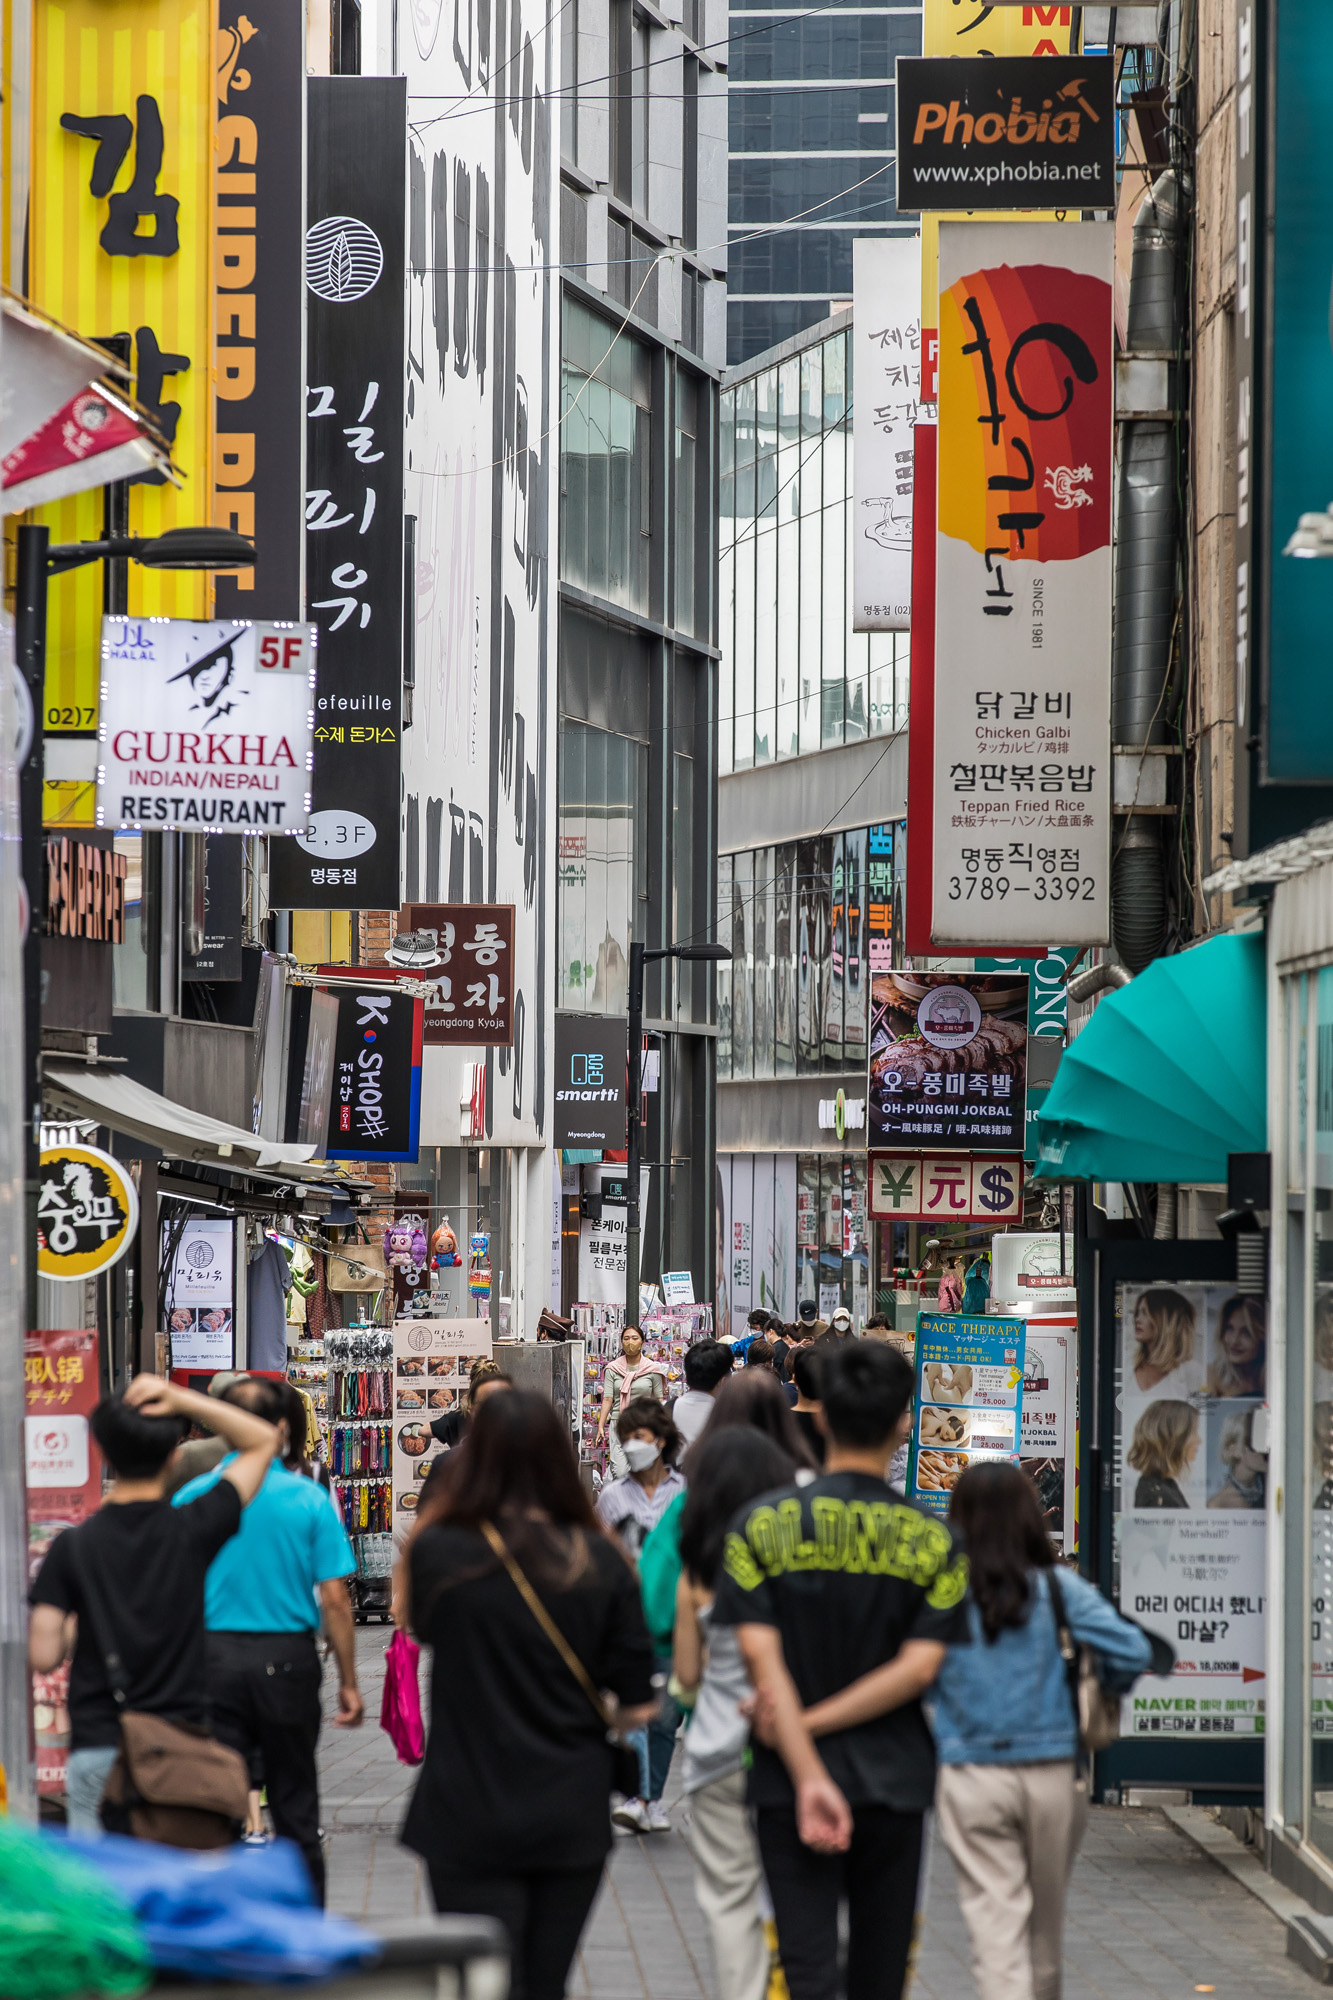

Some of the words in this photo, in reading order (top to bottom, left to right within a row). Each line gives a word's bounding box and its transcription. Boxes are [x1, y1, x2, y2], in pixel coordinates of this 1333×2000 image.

[913, 96, 1081, 145] Phobia
[913, 160, 1101, 187] www.xphobia.net
[1032, 578, 1045, 618] SINCE
[864, 605, 891, 616] 명동점
[894, 605, 911, 616] (02)
[1031, 622, 1043, 650] 1981
[109, 651, 156, 662] HALAL
[259, 636, 303, 670] 5F
[317, 694, 392, 711] efeuille
[975, 691, 1072, 720] 닭갈비
[47, 707, 96, 727] 02)7
[314, 726, 345, 744] 수제
[350, 726, 396, 744] 돈가스
[975, 726, 1031, 739] Chicken
[1036, 726, 1071, 739] Galbi
[112, 730, 299, 768] GURKHA
[129, 769, 280, 792] INDIAN/NEPALI
[949, 763, 1096, 793] 철판볶음밥
[121, 796, 287, 826] RESTAURANT
[959, 800, 1011, 815] Teppan
[1016, 799, 1052, 812] Fried
[1056, 799, 1085, 812] Rice
[961, 842, 1080, 874] 명동직영점
[310, 868, 358, 885] 명동점
[60, 835, 103, 940] SUPER
[104, 849, 127, 944] PET
[948, 877, 1096, 902] 3789-3392
[356, 995, 391, 1025] K
[423, 1018, 474, 1029] yeongdong
[478, 1018, 505, 1029] Kyoja
[881, 1071, 1013, 1097] 오-풍미족발
[556, 1088, 619, 1101] smartti
[881, 1103, 959, 1115] OH-PUNGMI
[961, 1105, 1013, 1116] JOKBAL
[567, 1131, 605, 1139] Myeongdong
[927, 1166, 967, 1210] 元
[978, 1165, 1014, 1213] $
[590, 1220, 628, 1234] 폰케이
[594, 1257, 627, 1272] 전문점
[931, 1322, 956, 1333] ACE
[961, 1323, 1022, 1337] THERAPY
[998, 1336, 1021, 1345] エステ
[979, 1355, 992, 1363] OK!
[1135, 1595, 1168, 1613] 머리
[1174, 1595, 1224, 1613] 어디서
[1230, 1595, 1266, 1616] 했니
[1134, 1699, 1197, 1711] NAVER
